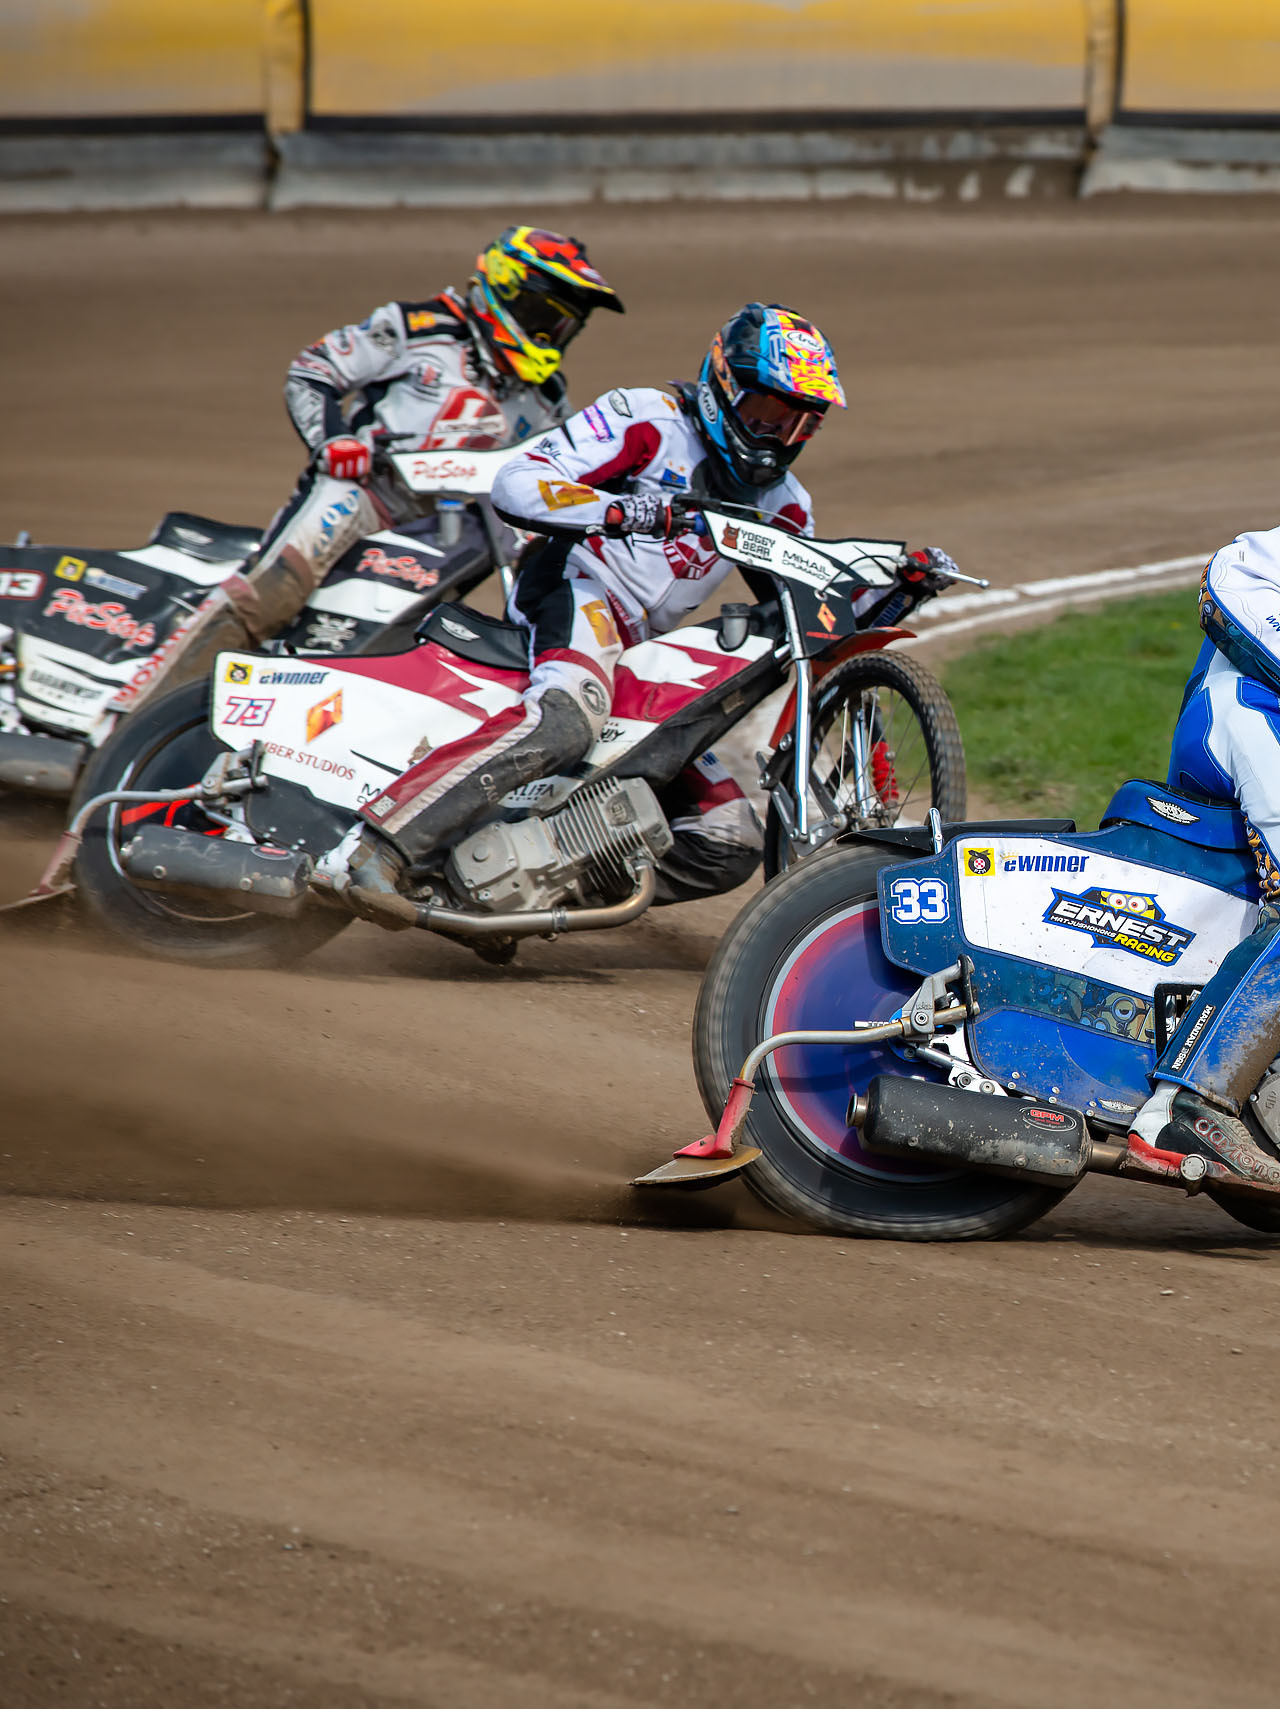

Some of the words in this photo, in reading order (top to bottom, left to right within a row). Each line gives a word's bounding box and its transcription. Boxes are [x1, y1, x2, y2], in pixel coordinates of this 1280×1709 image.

[782, 549, 832, 578] MIHAIL
[222, 696, 276, 727] 73
[295, 752, 357, 781] STUDIOS
[890, 878, 951, 925] 33
[1053, 899, 1187, 947] ERNEST
[1113, 933, 1176, 962] RACING
[1030, 1109, 1065, 1123] GPM
